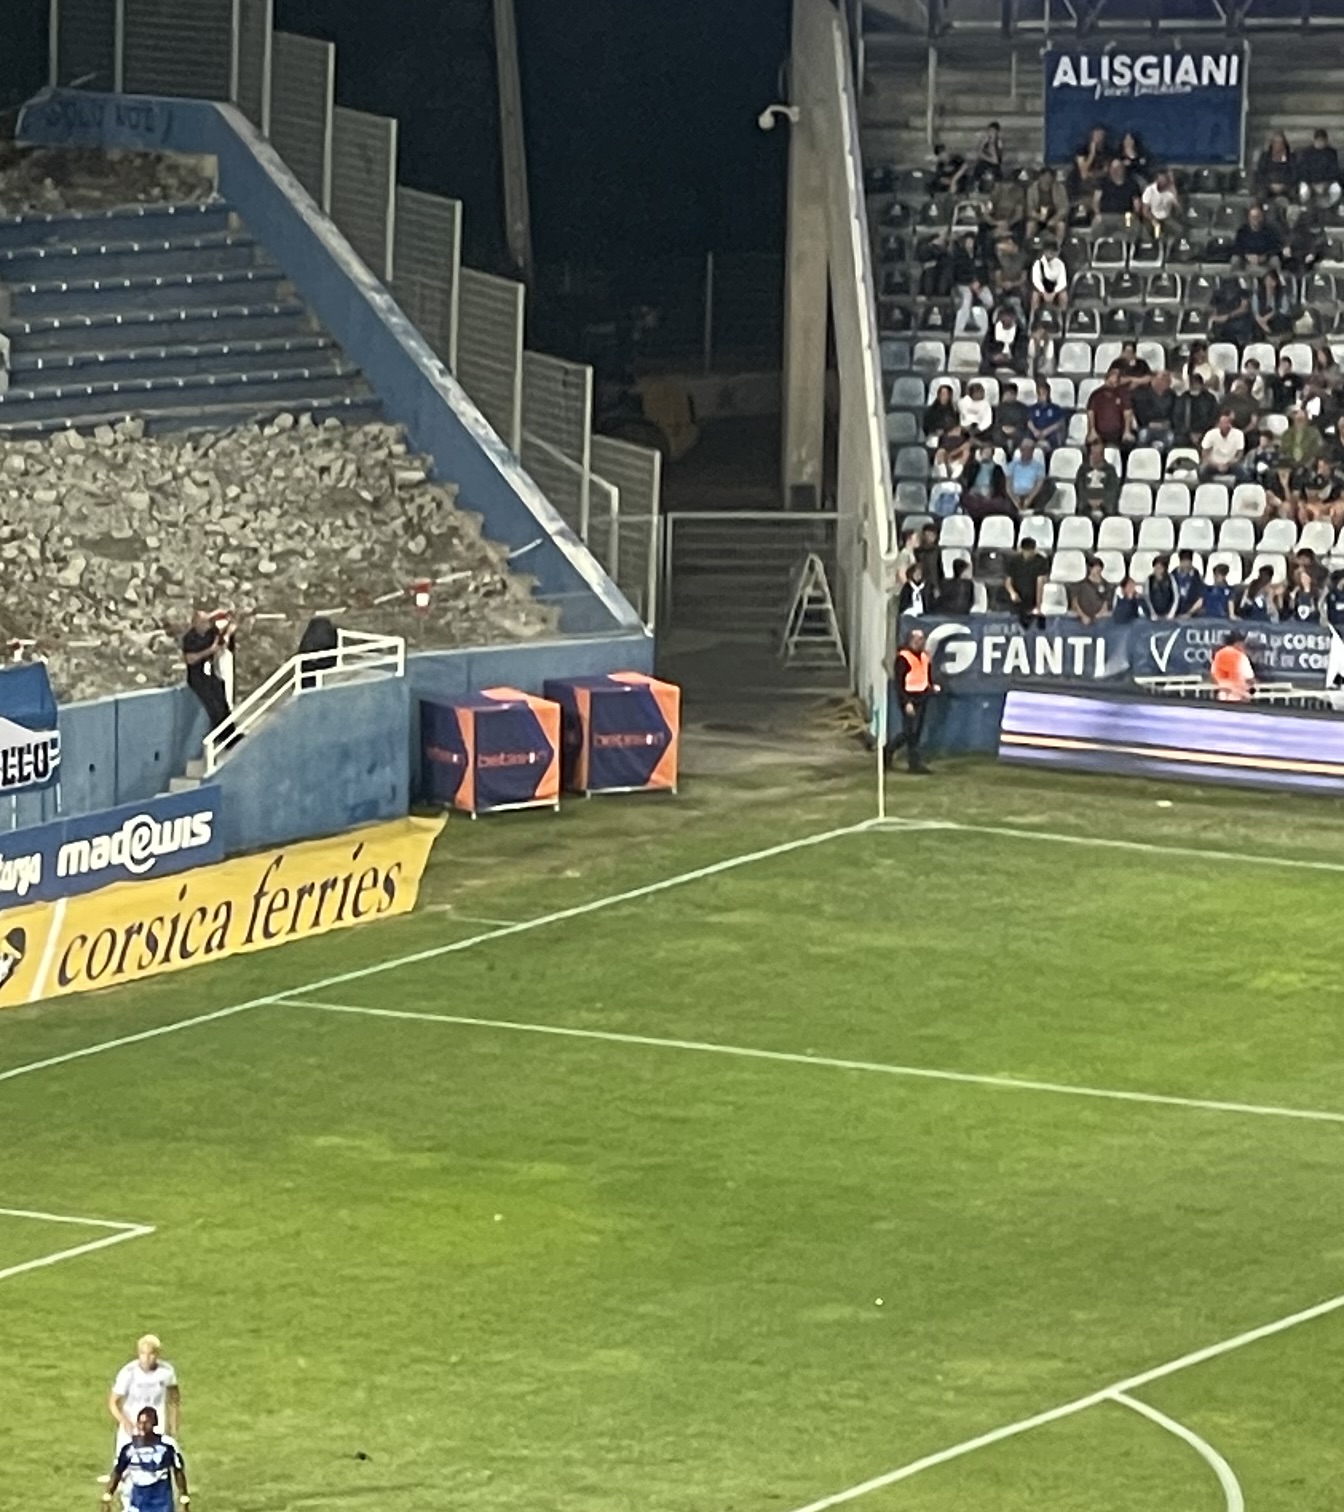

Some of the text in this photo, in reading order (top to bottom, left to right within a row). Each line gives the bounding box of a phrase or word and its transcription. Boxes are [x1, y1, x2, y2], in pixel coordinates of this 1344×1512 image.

[1052, 54, 1239, 87] ALISGIANI
[982, 636, 1106, 678] FANTI
[57, 842, 403, 987] corsica ferries
